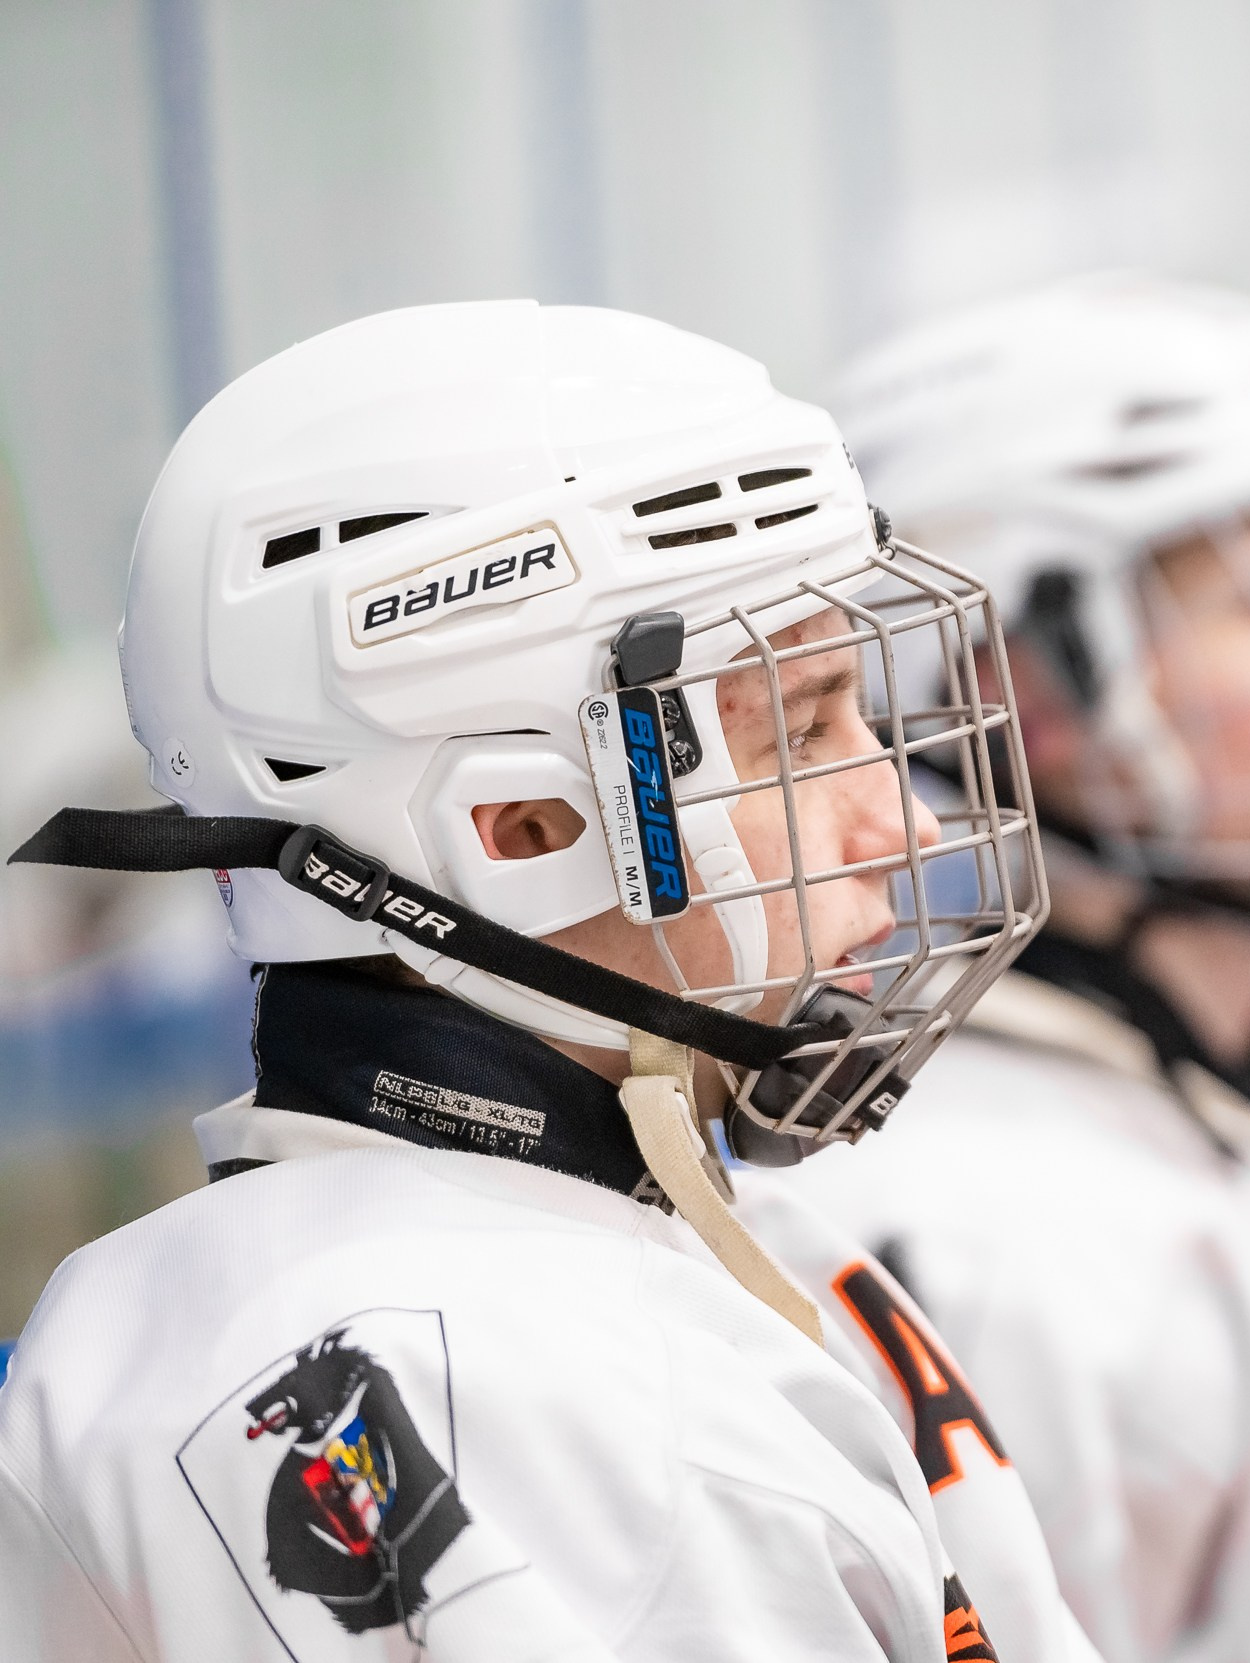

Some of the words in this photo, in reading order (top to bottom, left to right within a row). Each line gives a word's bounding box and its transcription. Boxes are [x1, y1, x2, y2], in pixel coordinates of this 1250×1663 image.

[363, 543, 556, 631] BAUER
[613, 784, 634, 847] PROFILE
[625, 865, 642, 907] M/M
[625, 708, 683, 900] BAUER
